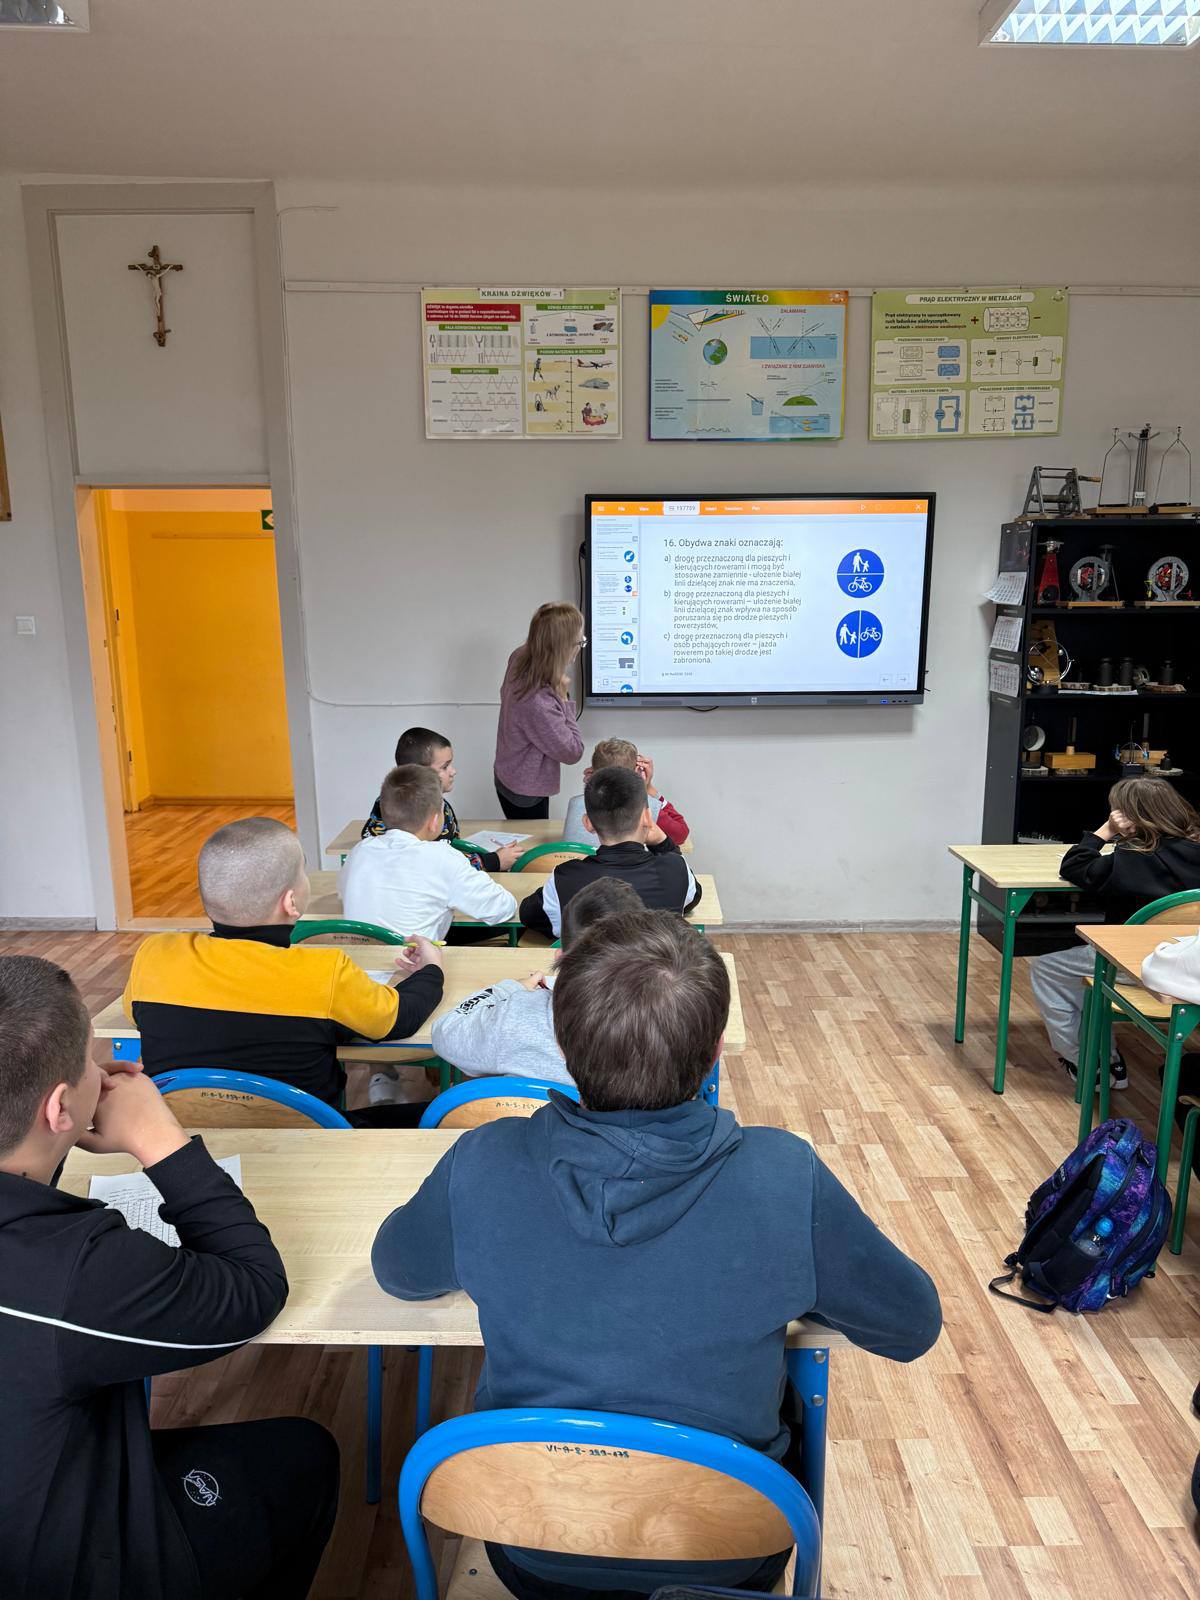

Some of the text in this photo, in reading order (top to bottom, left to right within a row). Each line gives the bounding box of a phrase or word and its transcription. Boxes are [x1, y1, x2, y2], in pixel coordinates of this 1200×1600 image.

[512, 290, 550, 298] DŹWIĘKÓW
[726, 292, 768, 303] ŚWIATŁO
[664, 538, 784, 549] 16. Obydwa znaki oznaczają:
[664, 555, 672, 563] a)
[674, 555, 695, 564] drogę
[696, 556, 744, 564] przeznaczoną
[757, 555, 787, 563] pieszych
[674, 563, 713, 572] kierujących
[750, 564, 770, 572] mogą
[772, 562, 784, 572] być
[782, 570, 801, 579] białej
[687, 580, 717, 588] dzielącej
[664, 590, 671, 598] b)
[674, 590, 694, 599] drogę
[696, 590, 742, 599] przeznaczoną
[756, 590, 785, 599] pieszych
[674, 598, 712, 606] kierujących
[783, 597, 801, 606] białej
[687, 606, 717, 615] dzielącej
[735, 606, 760, 614] wpływa
[772, 605, 797, 614] sposób
[674, 614, 710, 622] poruszania
[713, 614, 722, 622] się
[723, 614, 732, 622] po
[758, 613, 788, 622] pieszych
[664, 633, 670, 641] c)
[674, 633, 693, 642] drogę
[694, 633, 741, 642] przeznaczoną
[755, 632, 784, 641] pieszych
[692, 640, 730, 650] pchających
[758, 640, 776, 650] jazda
[705, 650, 714, 658] po
[715, 648, 734, 658] takiej
[759, 648, 772, 657] jest
[188, 1468, 216, 1507] NASA
